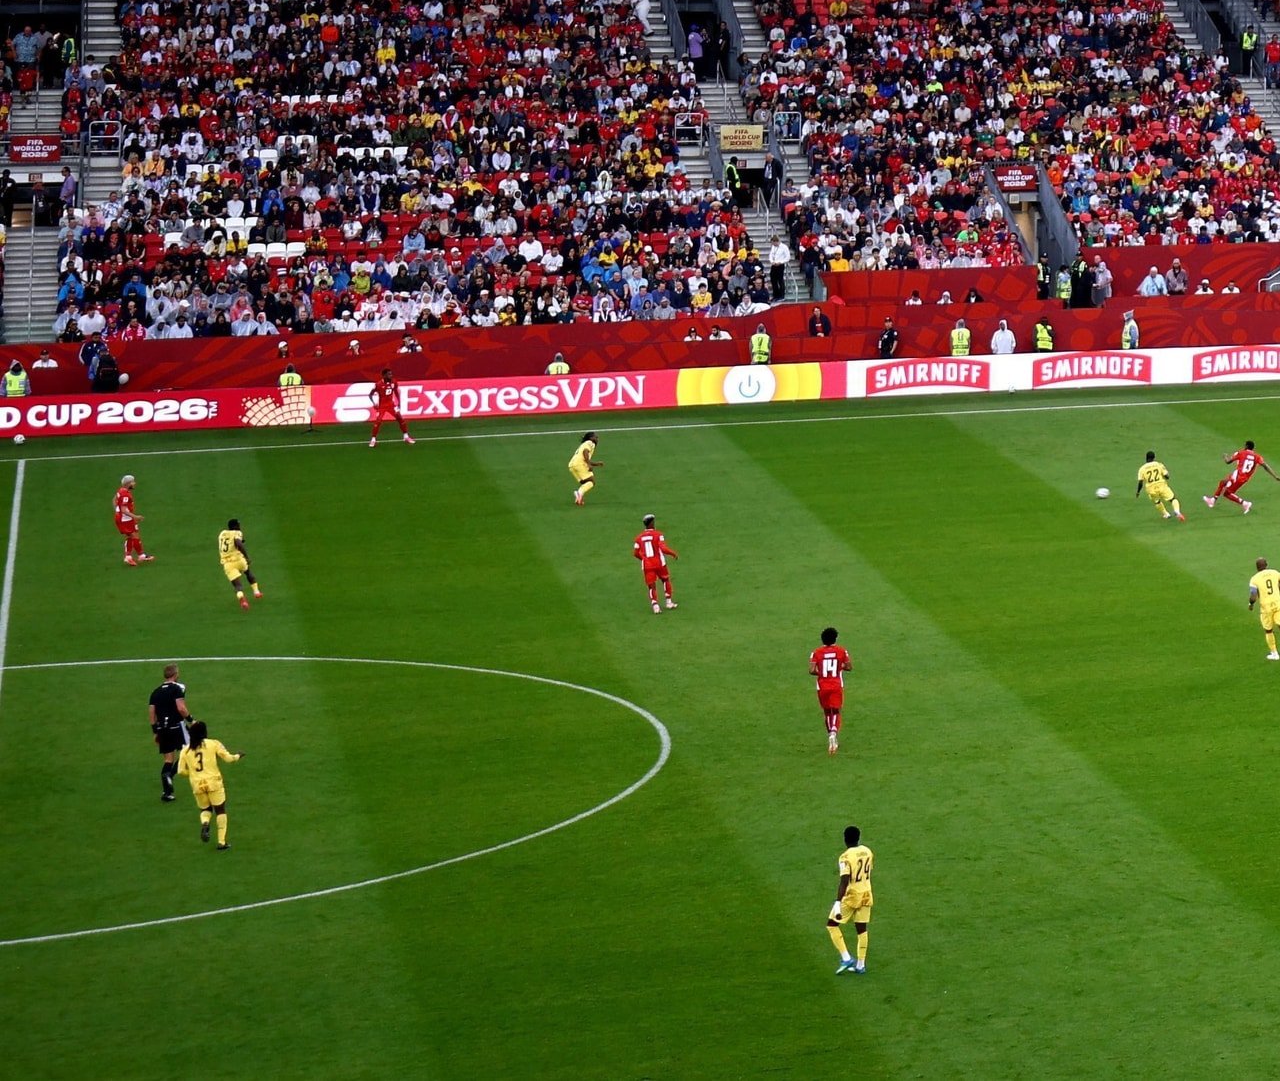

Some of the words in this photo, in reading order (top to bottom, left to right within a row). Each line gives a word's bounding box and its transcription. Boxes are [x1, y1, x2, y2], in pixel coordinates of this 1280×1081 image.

[875, 361, 982, 389] SMIRNOFF
[1040, 354, 1144, 381] SMIRNOFF
[399, 374, 646, 419] ExpressVPN
[36, 403, 92, 429] CUP
[96, 397, 208, 424] 2026
[1146, 468, 1160, 483] 22
[1265, 579, 1274, 595] 9
[822, 659, 838, 678] 14
[195, 752, 204, 772] 3
[855, 856, 870, 883] 24
